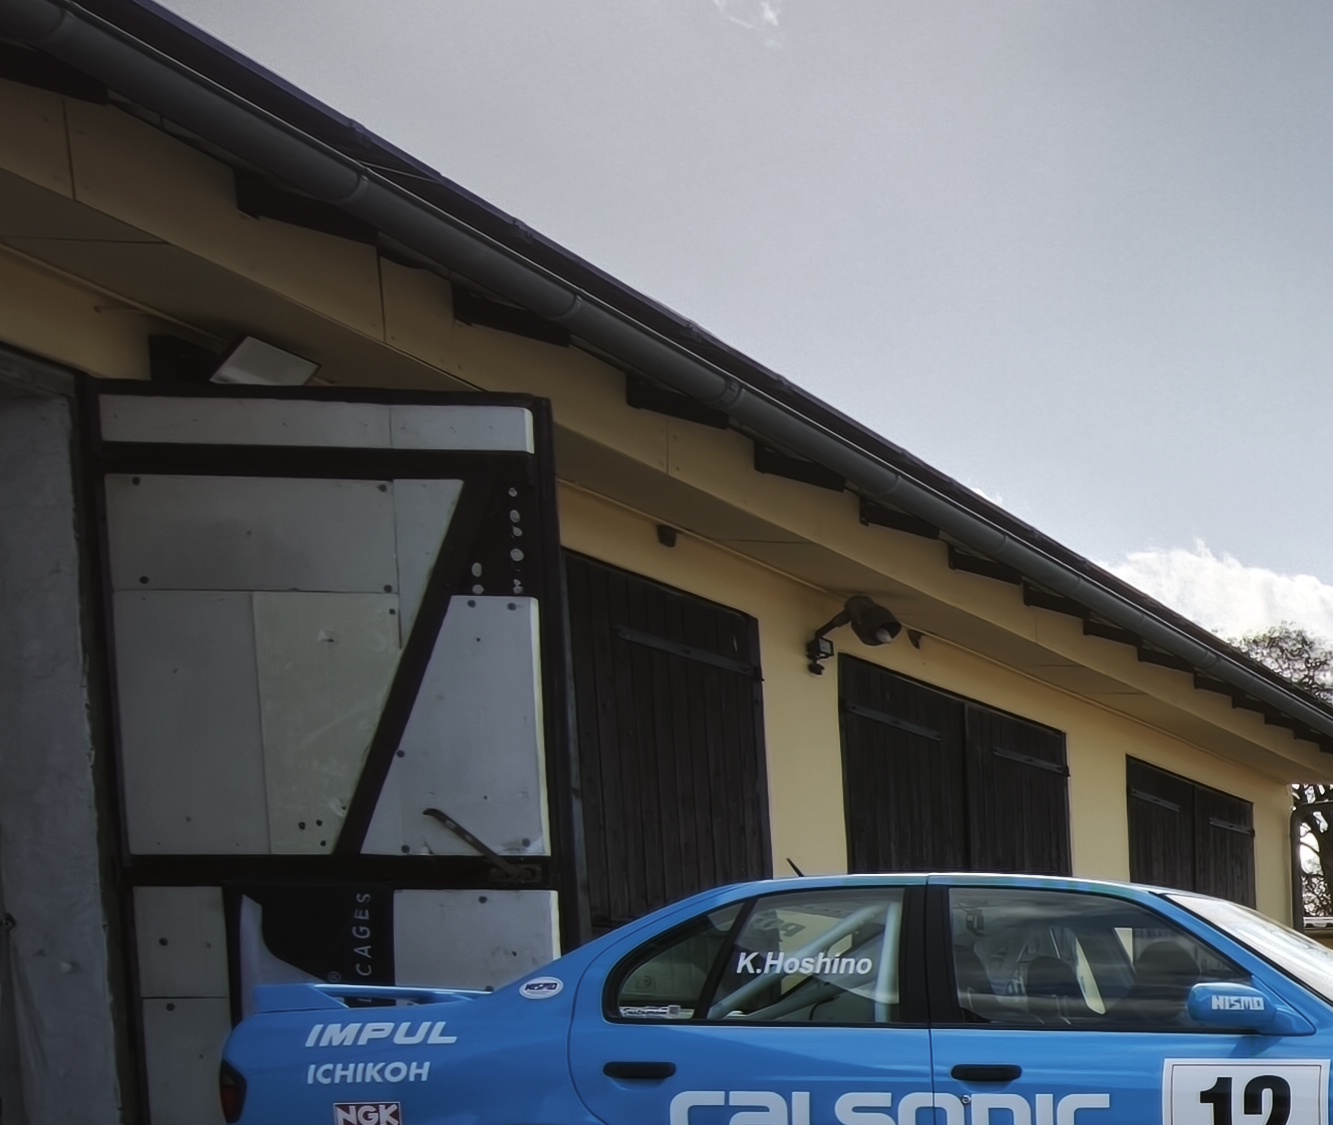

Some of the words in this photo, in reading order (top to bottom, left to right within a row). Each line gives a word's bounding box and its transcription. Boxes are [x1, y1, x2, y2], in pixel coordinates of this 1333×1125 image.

[352, 893, 372, 976] CAGES
[736, 952, 872, 974] K.Hoshino
[1211, 994, 1264, 1010] NISMO
[305, 1021, 458, 1047] IMPUL
[307, 1061, 431, 1085] ICHIKOH
